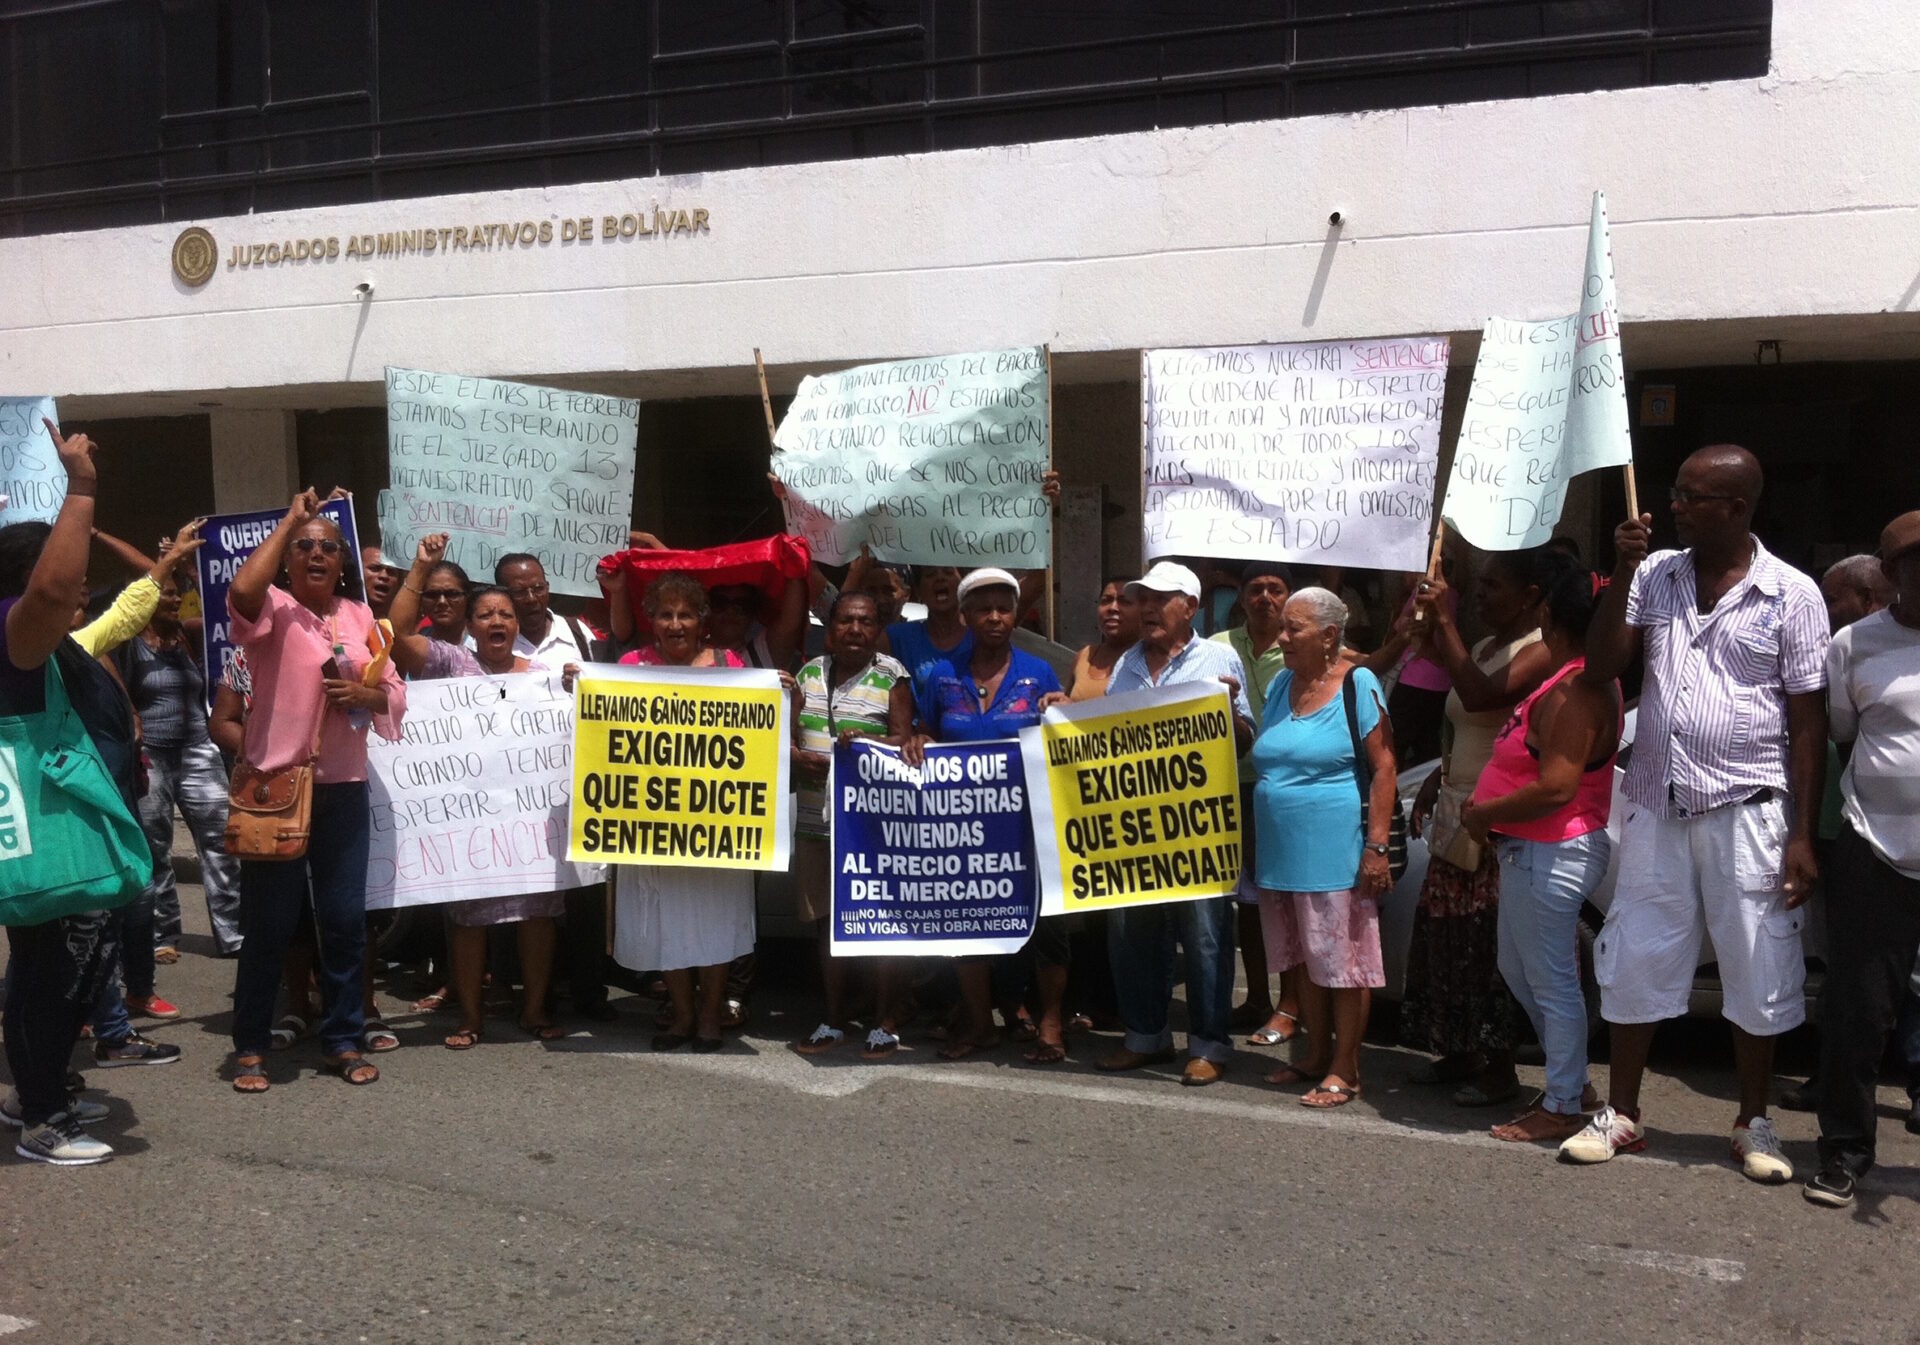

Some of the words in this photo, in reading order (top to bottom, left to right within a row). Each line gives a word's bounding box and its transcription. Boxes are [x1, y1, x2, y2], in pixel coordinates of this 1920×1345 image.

[227, 237, 339, 267] JUZGADOS
[345, 220, 553, 256] ADMINISTRATIVOS
[561, 217, 593, 242] DE
[602, 204, 710, 238] BOLÍVAR
[961, 357, 986, 376] DEL
[1268, 347, 1342, 374] NUESTRA
[457, 378, 487, 400] EL
[492, 384, 528, 407] MES
[538, 389, 560, 412] DE
[564, 394, 638, 420] FEBRERO
[950, 381, 1035, 409] ESTAMOS
[1189, 378, 1280, 406] CONDENE
[1294, 377, 1314, 402] AL
[480, 408, 618, 445] ESPERANDO
[1278, 405, 1291, 429] Y
[1300, 399, 1417, 424] MINISTERIO
[1294, 429, 1358, 453] TODOS
[1376, 425, 1424, 453] LOS
[423, 435, 450, 456] EL
[460, 438, 557, 472] JUZGADO
[571, 448, 619, 480] 13
[866, 459, 899, 486] QUE
[910, 463, 933, 483] SE
[945, 457, 977, 485] NOS
[1331, 457, 1345, 483] Y
[1352, 458, 1436, 489] MORALES
[1459, 453, 1507, 487] QUE
[550, 482, 621, 516] SAQUE
[864, 495, 927, 518] CASAS
[942, 494, 968, 518] AL
[981, 495, 1047, 518] PRECIO
[1279, 488, 1316, 512] POR
[1327, 490, 1347, 515] LA
[521, 512, 546, 538] DE
[553, 518, 628, 548] NUESTRA
[869, 524, 912, 553] DEL
[1207, 518, 1341, 550] ESTADO
[475, 711, 502, 737] DE
[580, 693, 647, 724] LLEVAMOS
[699, 700, 776, 730] ESPERANDO
[608, 729, 745, 770] EXIGIMOS
[1048, 731, 1107, 766] LLEVAMOS
[1153, 710, 1228, 750] ESPERANDO
[392, 752, 483, 790] CUANDO
[967, 753, 1008, 785] QUE
[1077, 751, 1208, 805] EXIGIMOS
[583, 772, 639, 813] QUE
[645, 776, 681, 812] SE
[689, 778, 767, 816] DICTE
[843, 786, 917, 816] PAGUEN
[922, 786, 1023, 816] NUESTRAS
[371, 790, 502, 832] ESPERAR
[1065, 813, 1117, 858] QUE
[1120, 808, 1156, 847] SE
[1159, 795, 1238, 841] DICTE
[582, 818, 762, 860] SENTENCIA!!!
[881, 821, 984, 848] VIVIENDAS
[842, 853, 871, 874] AL
[878, 854, 961, 876] PRECIO
[968, 852, 1026, 874] REAL
[1072, 843, 1240, 900] SENTENCIA!!!
[851, 880, 894, 901] DEL
[900, 879, 1014, 902] MERCADO
[844, 922, 866, 934] SIN
[869, 921, 908, 934] VIGAS
[911, 922, 919, 933] Y
[923, 921, 940, 933] EN
[943, 920, 981, 933] OBRA
[984, 918, 1028, 931] NEGRA
[878, 909, 902, 919] MAS
[905, 909, 941, 919] CAJAS
[944, 909, 959, 918] DE
